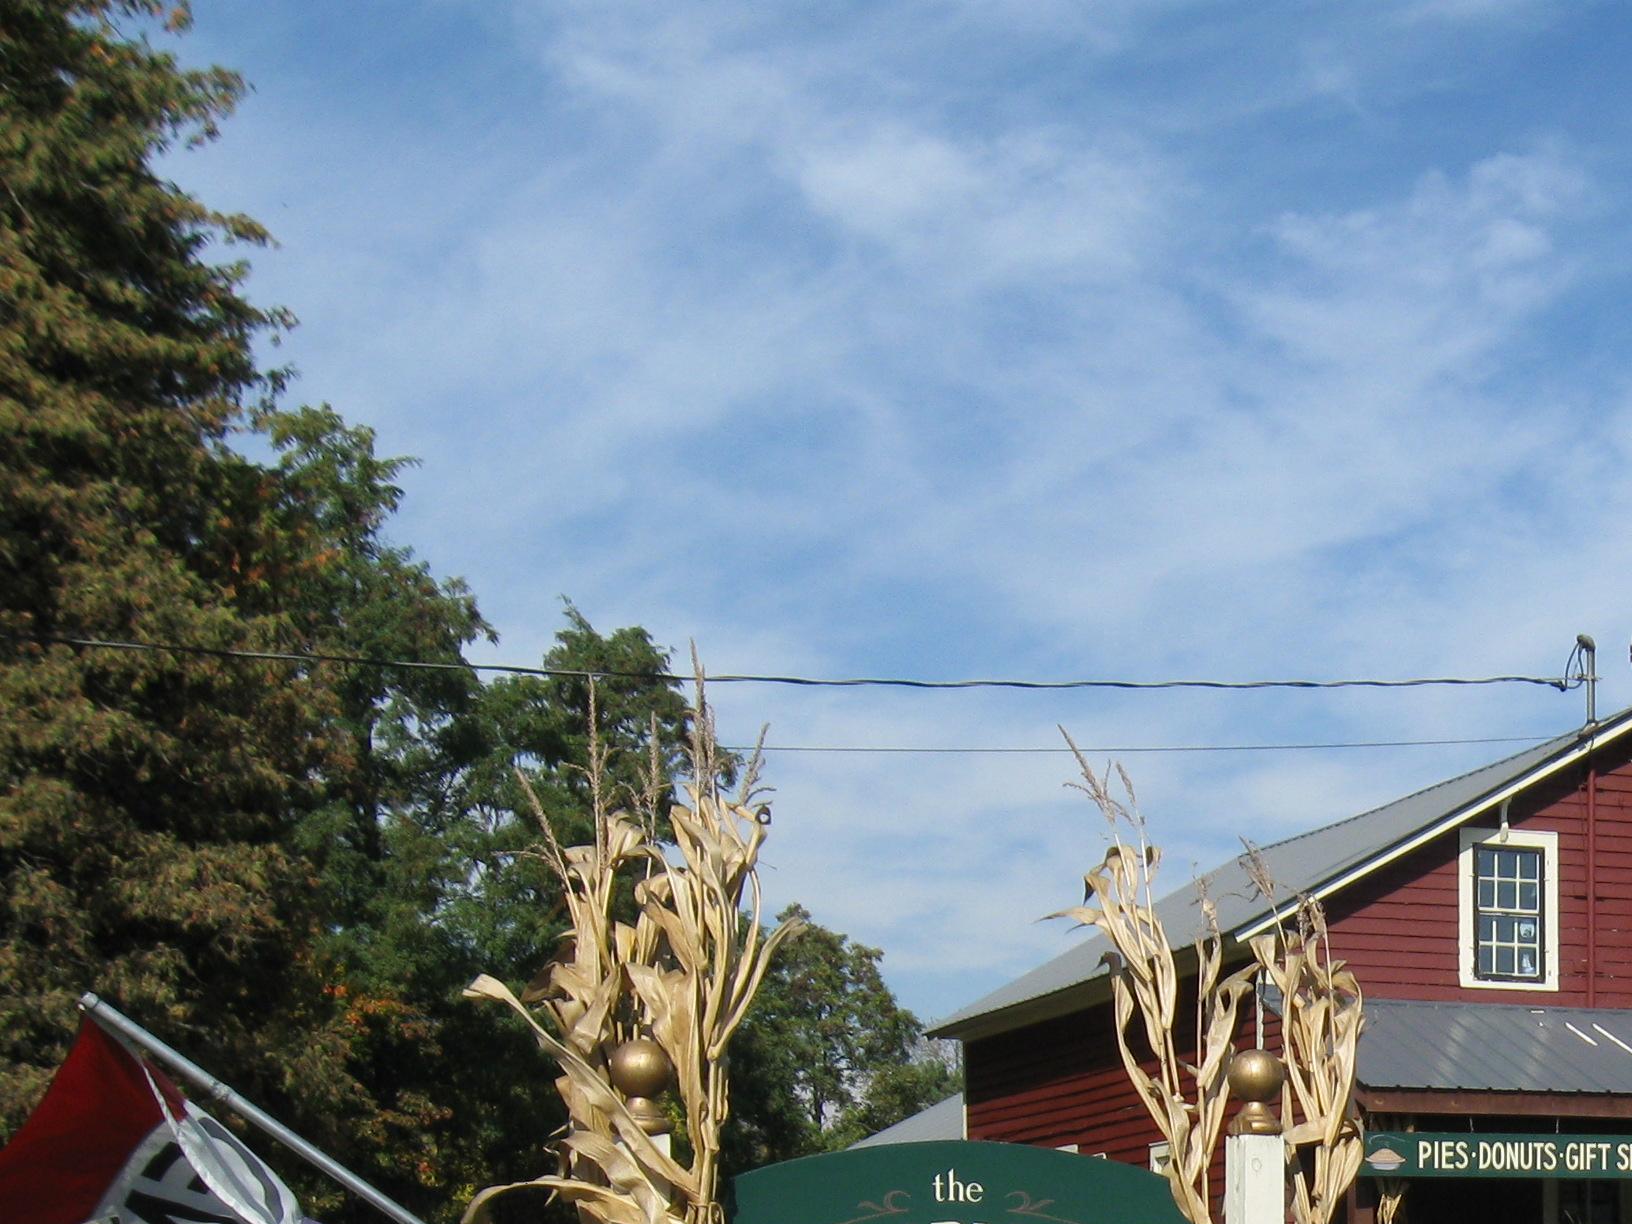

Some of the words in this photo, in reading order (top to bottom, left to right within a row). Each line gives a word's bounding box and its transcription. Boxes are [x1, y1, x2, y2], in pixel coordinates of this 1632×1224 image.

[1418, 1140, 1469, 1170] PIES
[1478, 1141, 1557, 1171] DONUTS
[1565, 1142, 1612, 1171] GIFT
[932, 1168, 984, 1203] the
